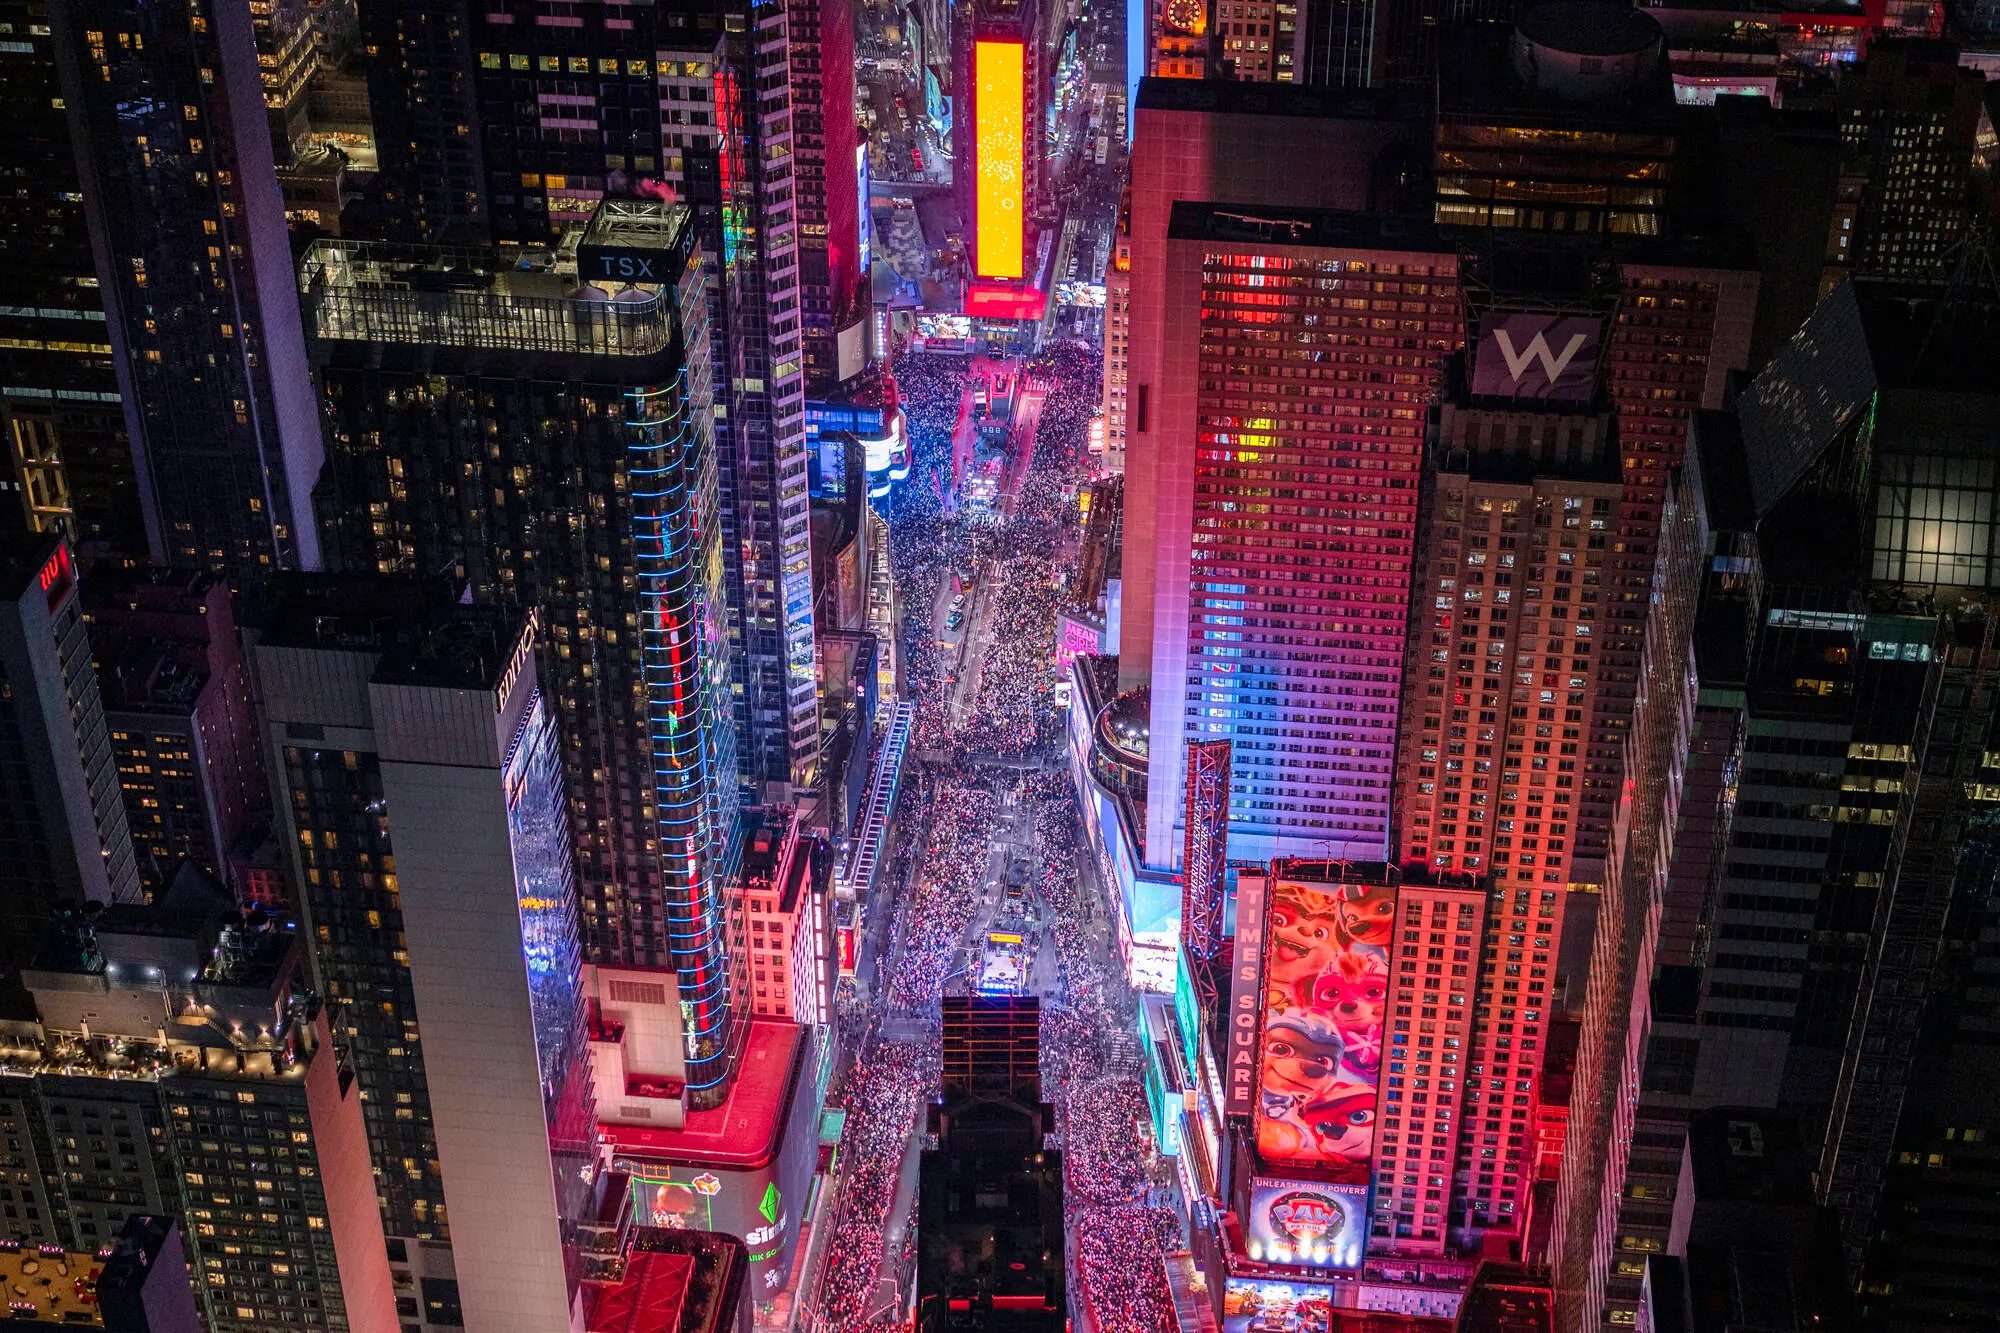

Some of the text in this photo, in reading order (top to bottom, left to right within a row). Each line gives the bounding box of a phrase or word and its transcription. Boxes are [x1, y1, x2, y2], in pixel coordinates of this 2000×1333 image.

[600, 256, 653, 277] TSX
[1493, 328, 1588, 385] W
[1065, 622, 1098, 645] MEAN
[1065, 633, 1098, 655] GIRLS
[497, 605, 540, 714] EDITION
[1193, 802, 1203, 840] EAGLE
[1198, 824, 1209, 896] OUTFITTERS
[1234, 889, 1261, 1101] TIMES SQUARE
[1256, 1179, 1366, 1195] UNLEASH YOUR POWERS
[1273, 1205, 1341, 1226] PAW
